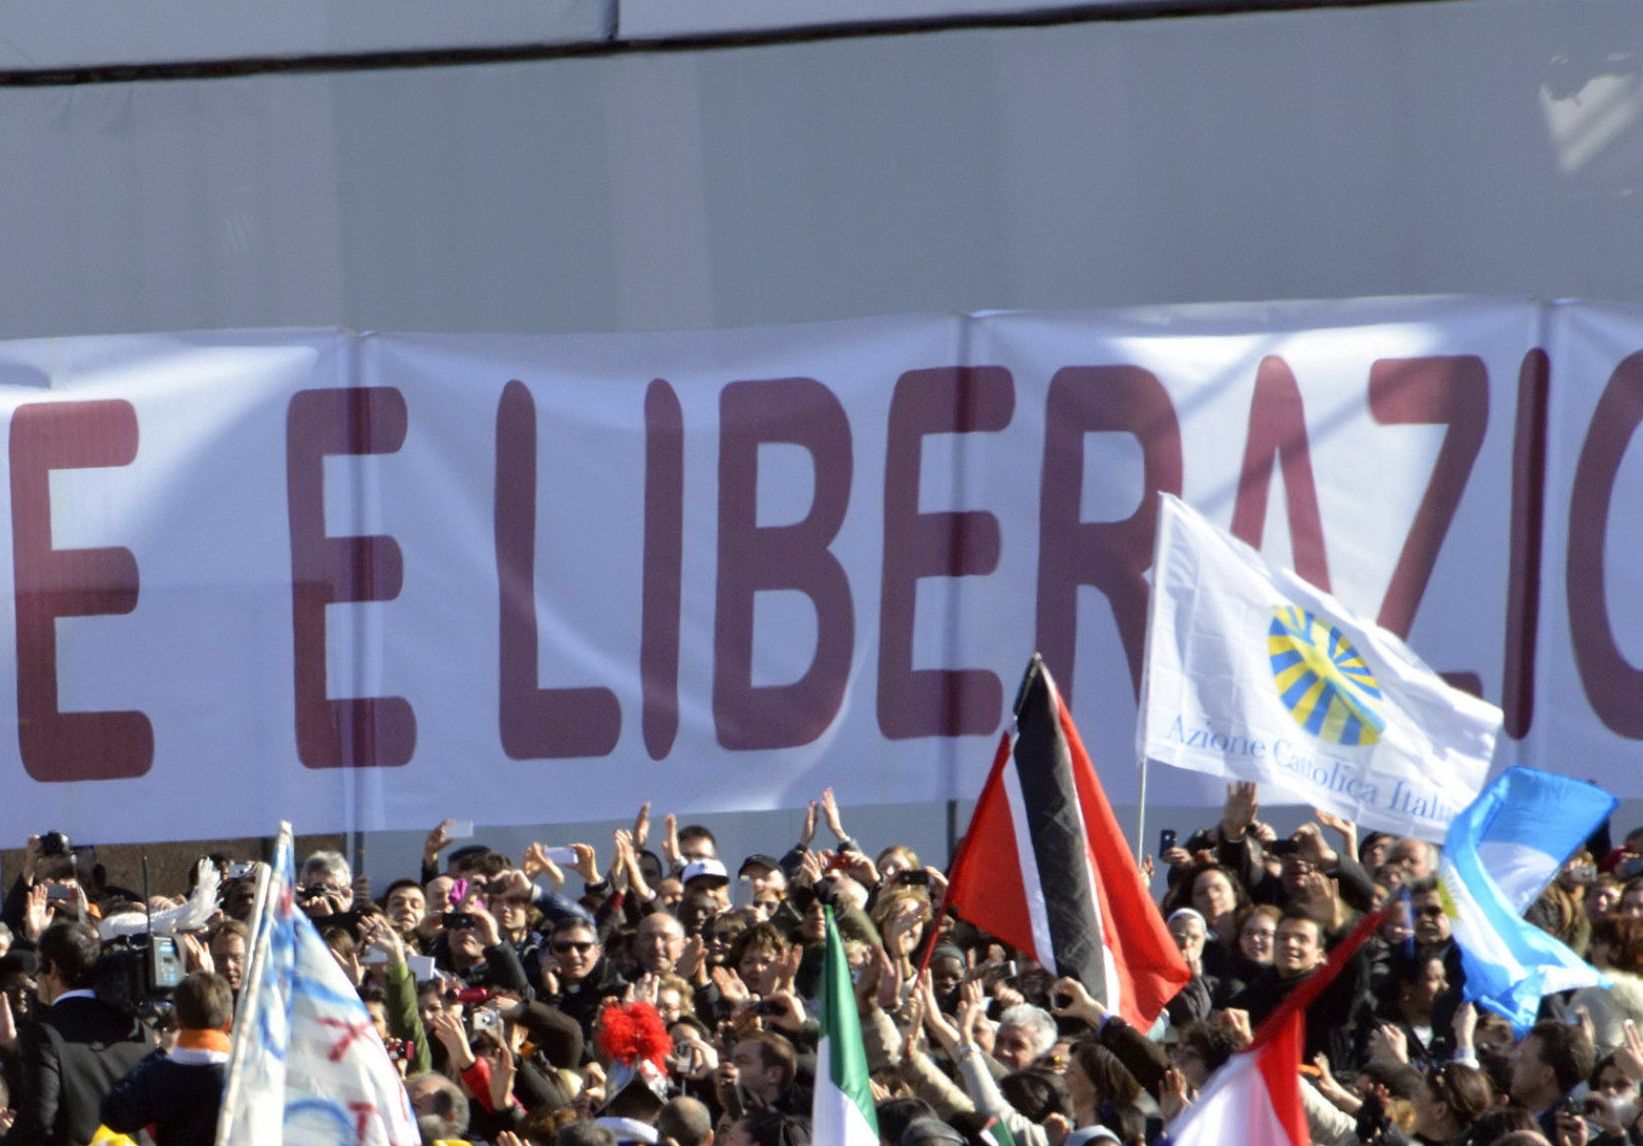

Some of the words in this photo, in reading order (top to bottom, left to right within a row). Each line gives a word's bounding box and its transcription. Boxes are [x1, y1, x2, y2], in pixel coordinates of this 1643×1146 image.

[285, 385, 418, 769] E
[1165, 714, 1267, 758] Azione
[1271, 737, 1381, 806] Cattolica
